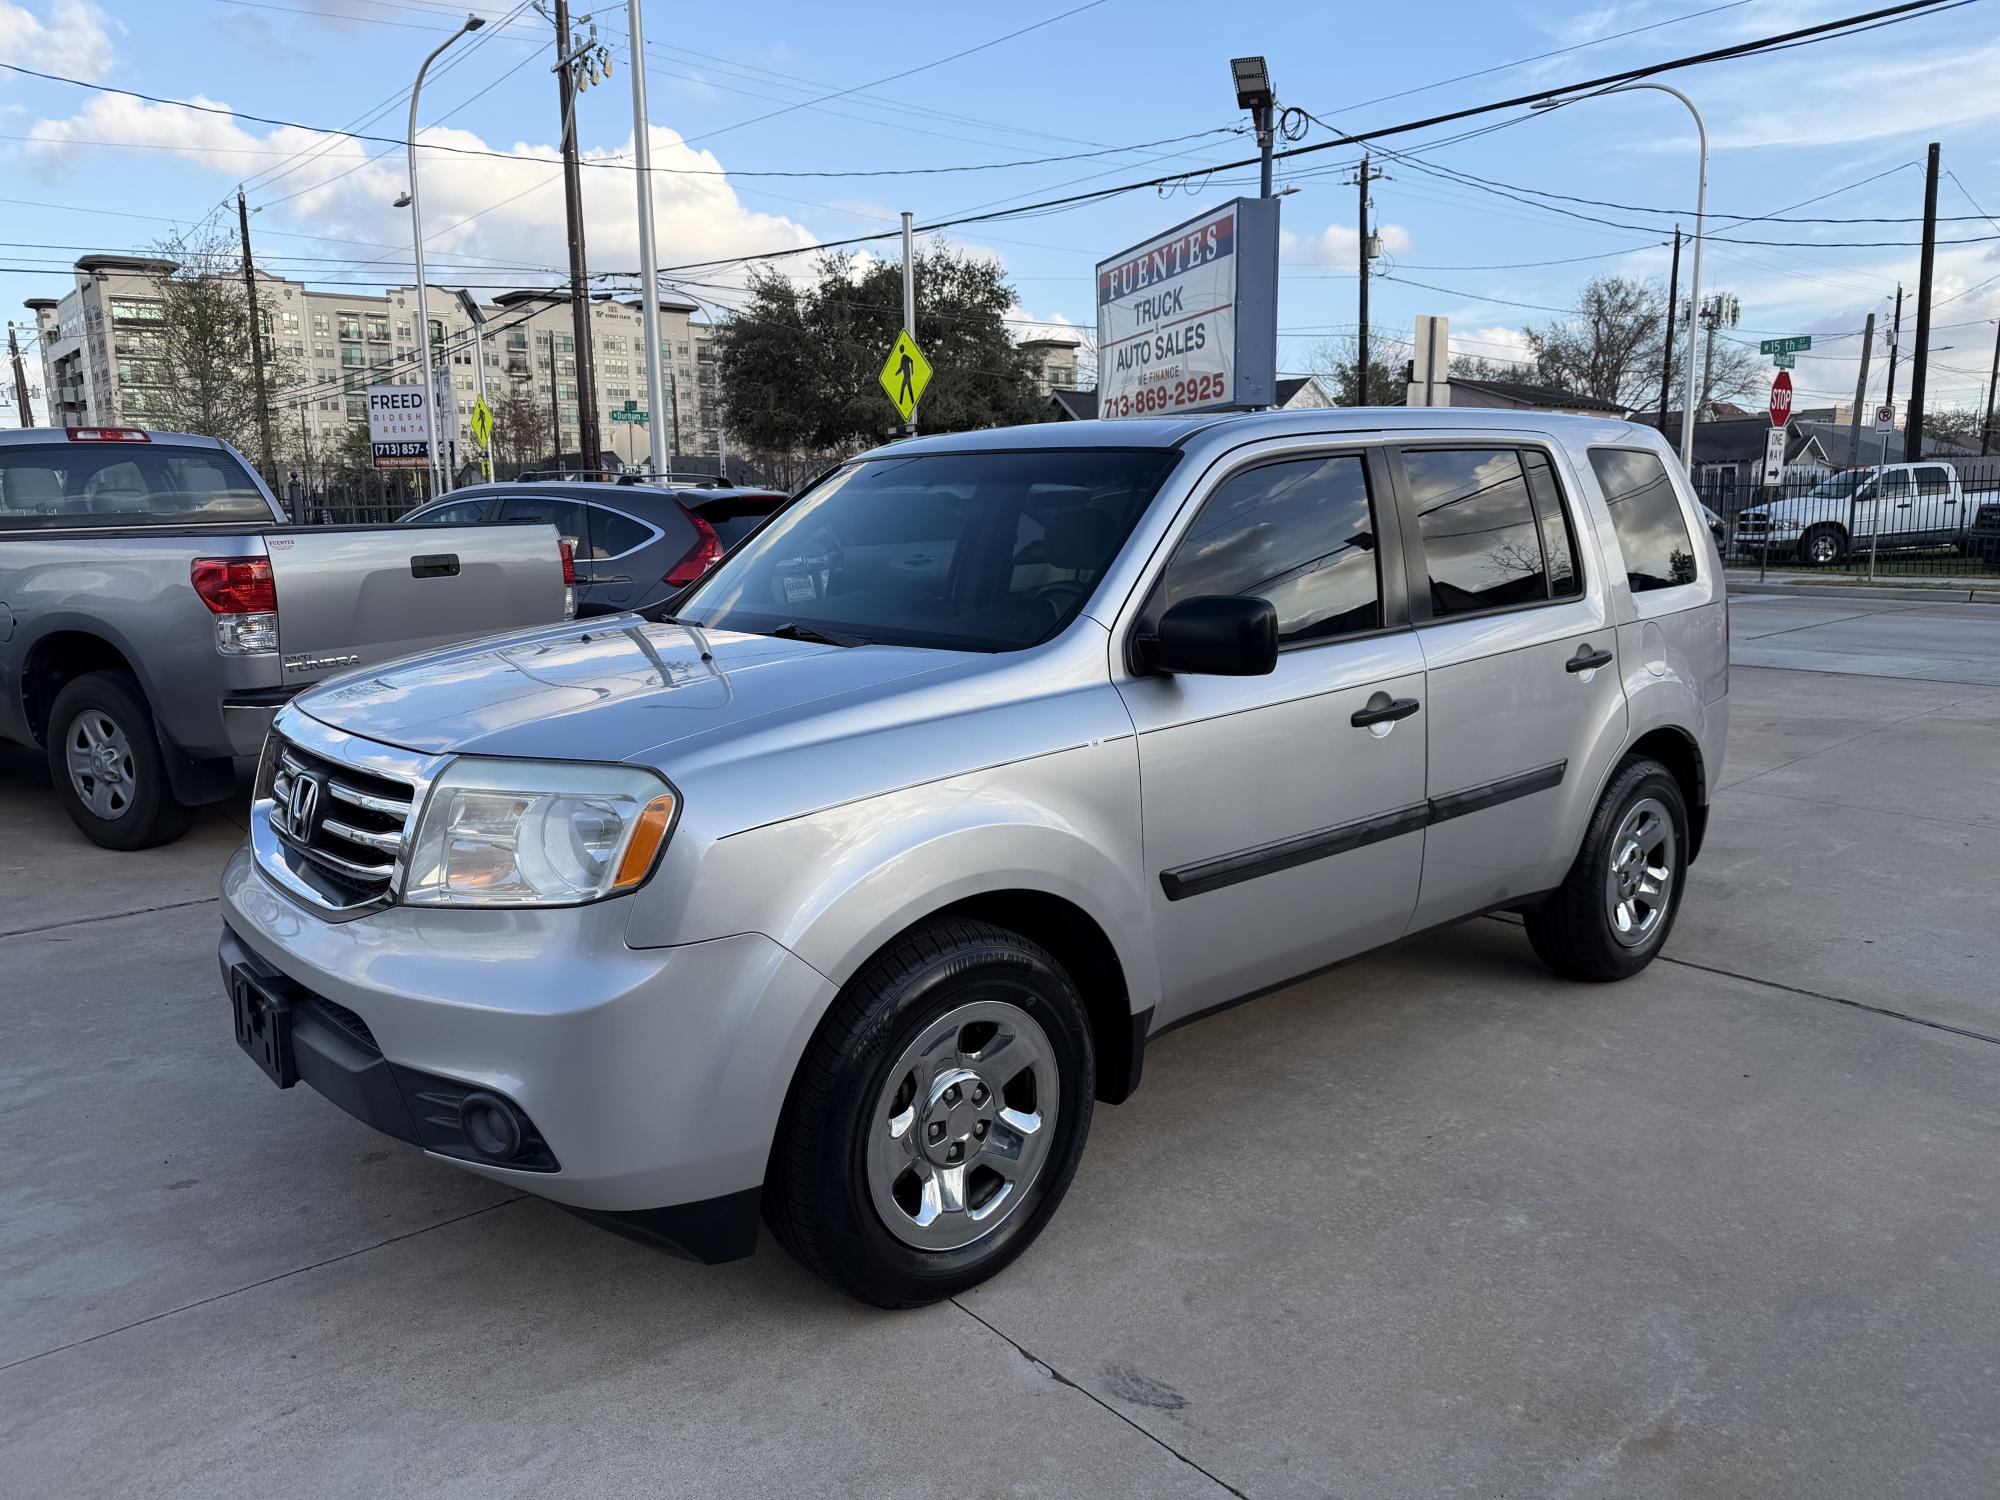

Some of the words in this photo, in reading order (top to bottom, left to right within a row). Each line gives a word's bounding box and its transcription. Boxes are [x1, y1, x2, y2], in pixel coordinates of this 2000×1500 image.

[1109, 225, 1217, 300] FUENTES
[1134, 286, 1184, 326] TRUCK
[1116, 340, 1151, 372] AUTO
[1155, 323, 1205, 360] SALES
[1771, 341, 1781, 352] 15
[1137, 372, 1147, 385] WE
[1149, 365, 1180, 384] FINANCE
[1105, 372, 1225, 418] 713-869-2925
[1771, 388, 1792, 411] STOP
[618, 412, 641, 421] Durham
[384, 425, 441, 433] RENTAS
[1771, 433, 1783, 446] ONE
[375, 443, 400, 456] (713)
[1769, 449, 1783, 462] WAY
[285, 655, 361, 673] TUNDRA
